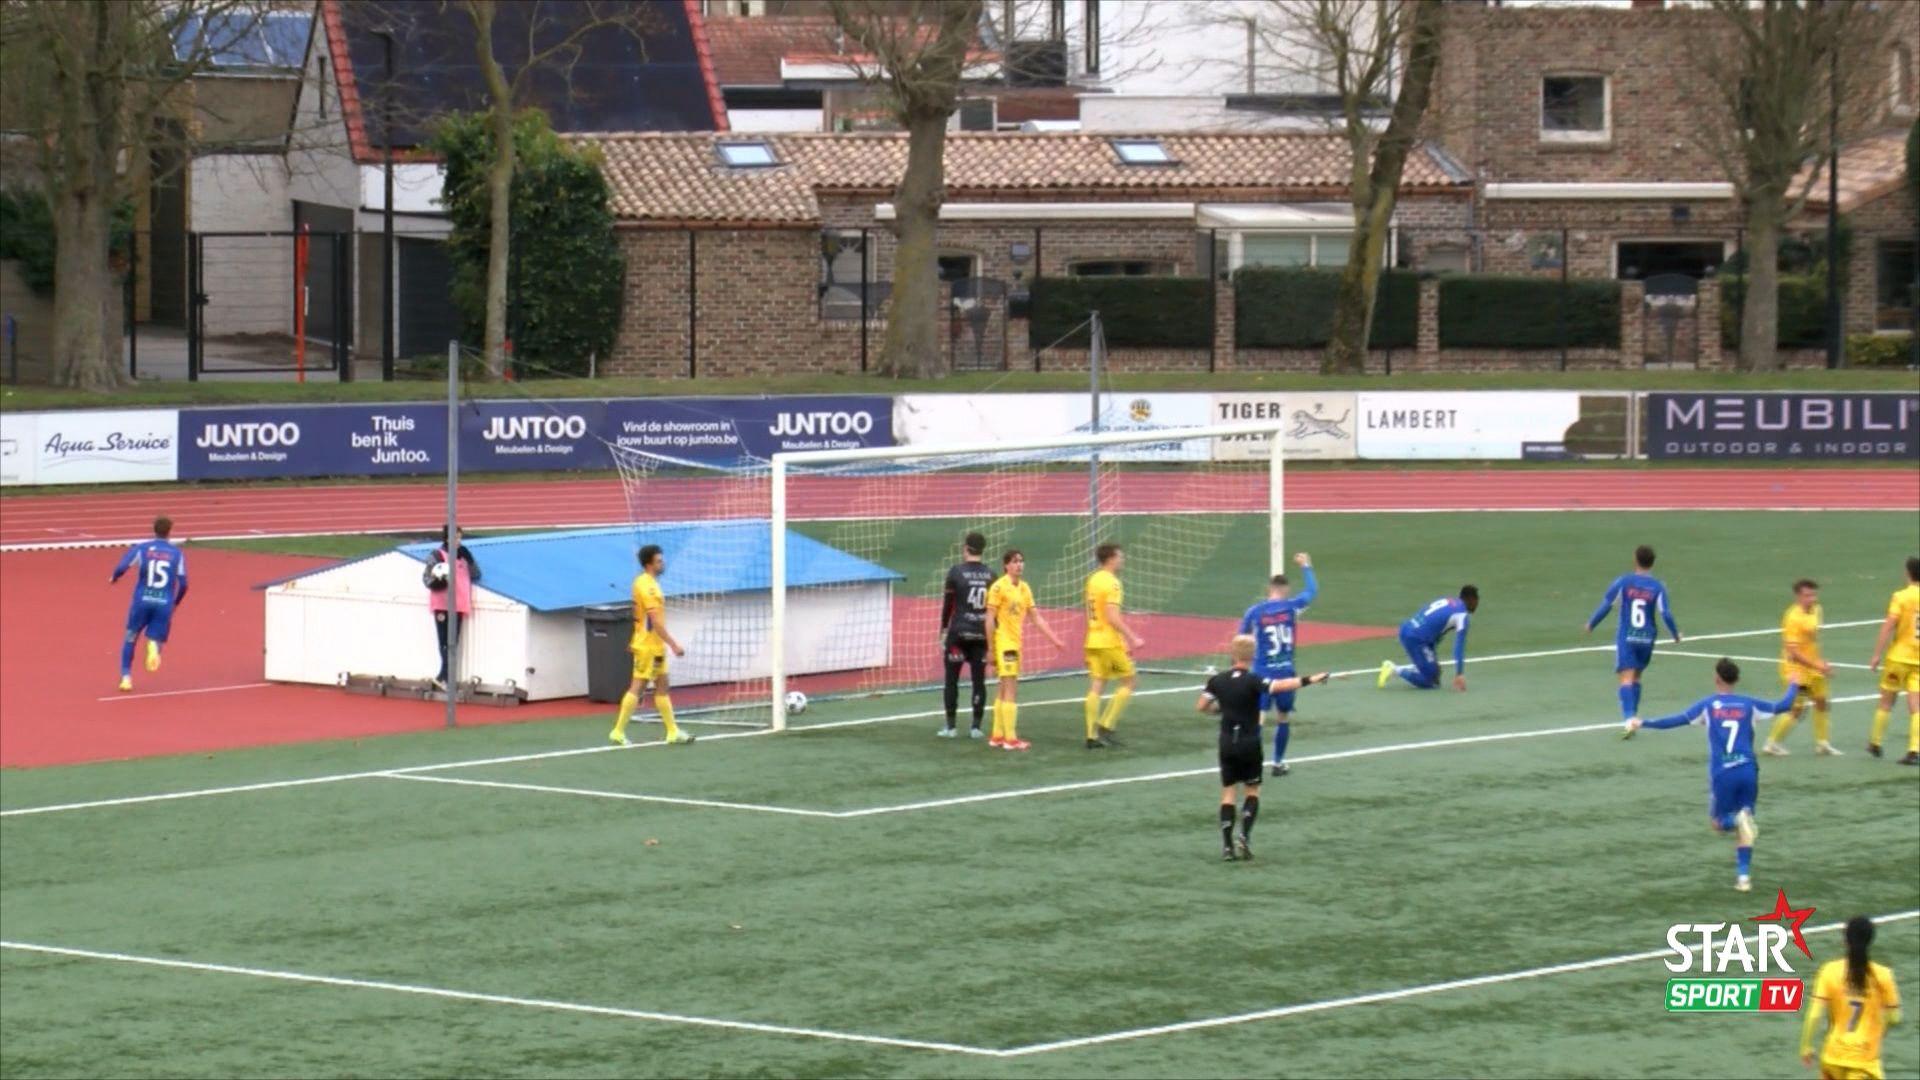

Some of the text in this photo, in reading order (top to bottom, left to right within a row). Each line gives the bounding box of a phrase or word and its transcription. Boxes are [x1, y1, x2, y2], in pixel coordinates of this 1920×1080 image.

[1218, 402, 1281, 419] TIGER
[1367, 409, 1457, 429] LAMBERT
[372, 416, 415, 431] Thuis
[483, 415, 586, 440] JUNTOO
[622, 421, 730, 432] Vind de showroom in
[769, 411, 872, 437] JUNTOO
[45, 431, 171, 456] Aqua Service
[196, 422, 300, 448] JUNTOO
[352, 431, 398, 447] ben ik
[617, 433, 738, 447] jouw buurt op juntoo.be
[208, 452, 249, 462] Meubelen
[259, 451, 287, 462] Design
[371, 447, 431, 463] Juntoo.
[495, 445, 535, 454] Meubelen
[544, 443, 573, 455] Design
[1666, 442, 1907, 453] OUTDOOR & INDOOR
[147, 559, 170, 588] 15
[967, 587, 987, 609] 40
[1631, 598, 1646, 628] 6
[1265, 623, 1293, 656] 34
[1722, 720, 1739, 754] 7
[1848, 999, 1865, 1033] 7
